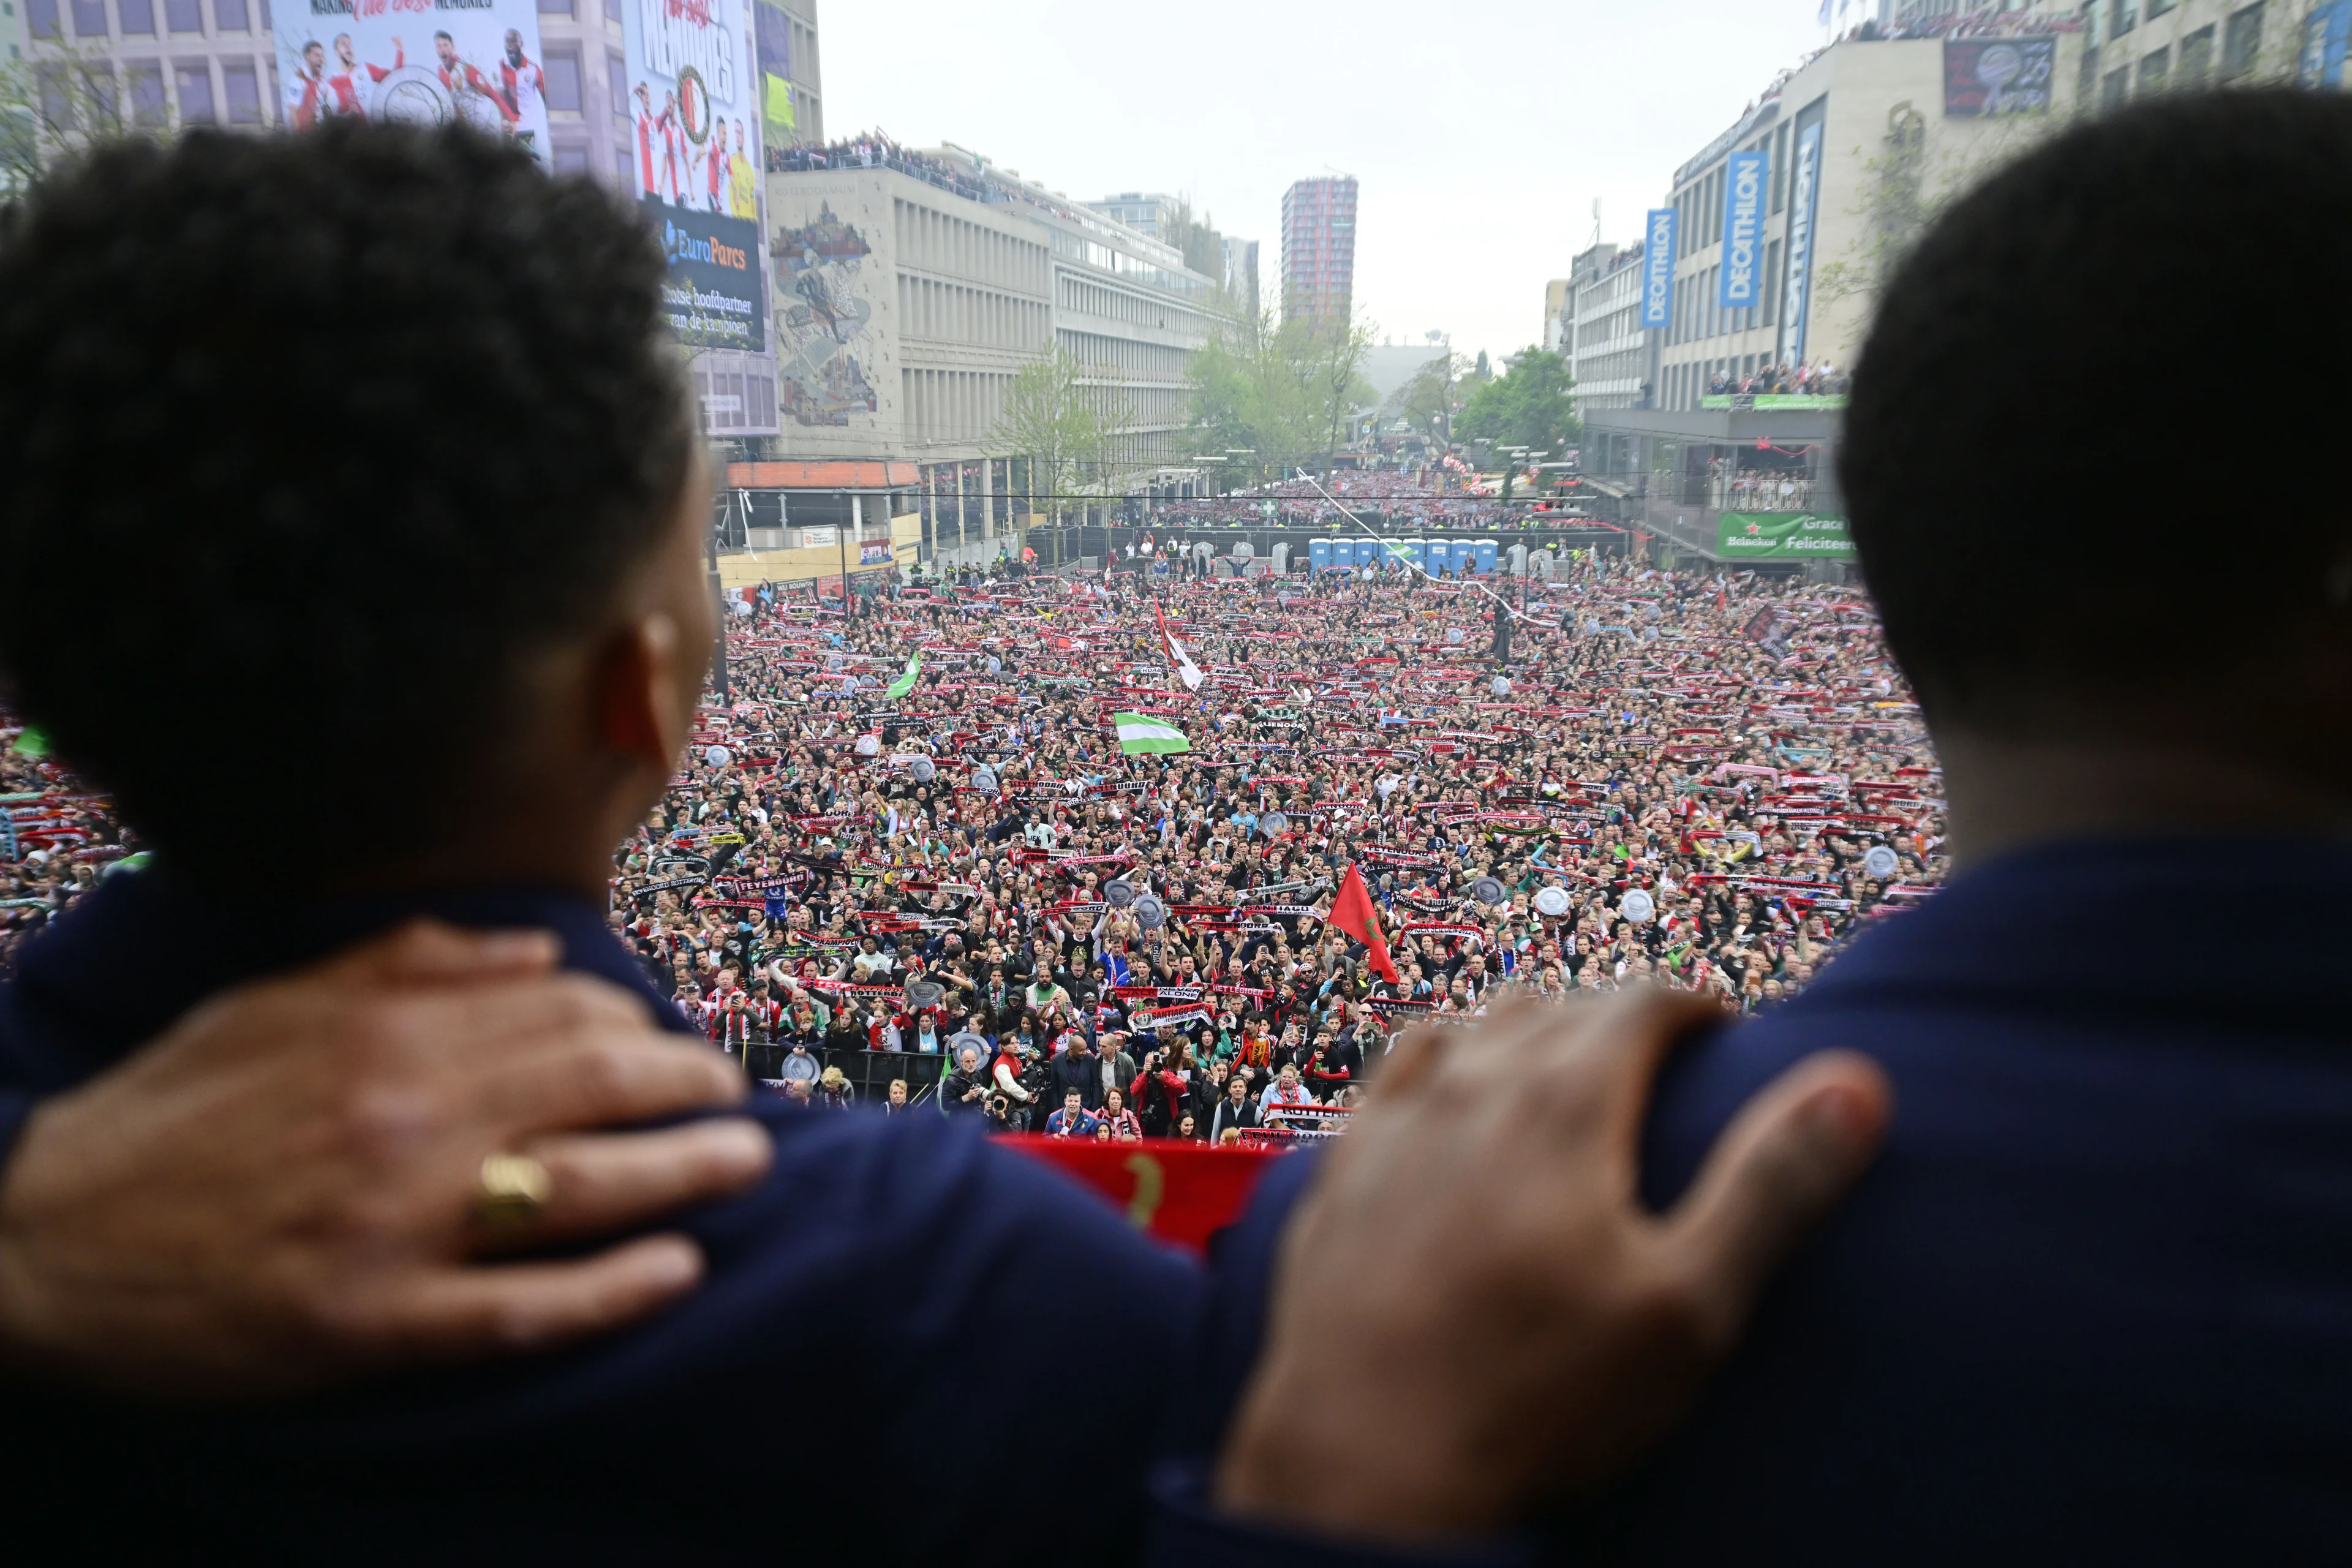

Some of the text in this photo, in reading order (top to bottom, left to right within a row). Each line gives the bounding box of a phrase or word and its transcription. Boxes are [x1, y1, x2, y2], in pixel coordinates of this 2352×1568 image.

[774, 186, 856, 197] ROTERODAMUM
[1728, 159, 1760, 300] DECATHLON
[677, 228, 747, 271] EuroParcs
[1648, 214, 1672, 322] DECATHLON
[693, 287, 752, 315] hoofdpartner
[669, 313, 687, 329] van
[690, 311, 701, 330] de
[1728, 537, 1778, 547] Heineken
[1393, 751, 1419, 760] ROTTERDAM
[1012, 780, 1063, 790] FEYENOORD
[1087, 782, 1146, 794] FEYENOORD
[1550, 811, 1607, 821] FEYENOORD
[1368, 845, 1430, 857] FEYENOORD
[867, 859, 922, 872] LANDSKAMPIOEN
[631, 881, 669, 896] FEYENOORD
[670, 876, 706, 888] ROTTERDAM
[740, 873, 804, 889] FEYENOORD
[1261, 880, 1302, 892] FEYENOORD
[940, 883, 968, 894] KAMPIOEN
[697, 900, 766, 910] FEYENOOR
[1396, 894, 1412, 906] YOU'LL
[1412, 901, 1430, 912] NEVER
[901, 921, 918, 930] The
[1430, 924, 1458, 933] SEIZOEN
[1229, 987, 1264, 997] LEGIOEN
[1152, 1006, 1189, 1020] SANTIAGO
[1187, 1011, 1208, 1020] ROTTERDAM
